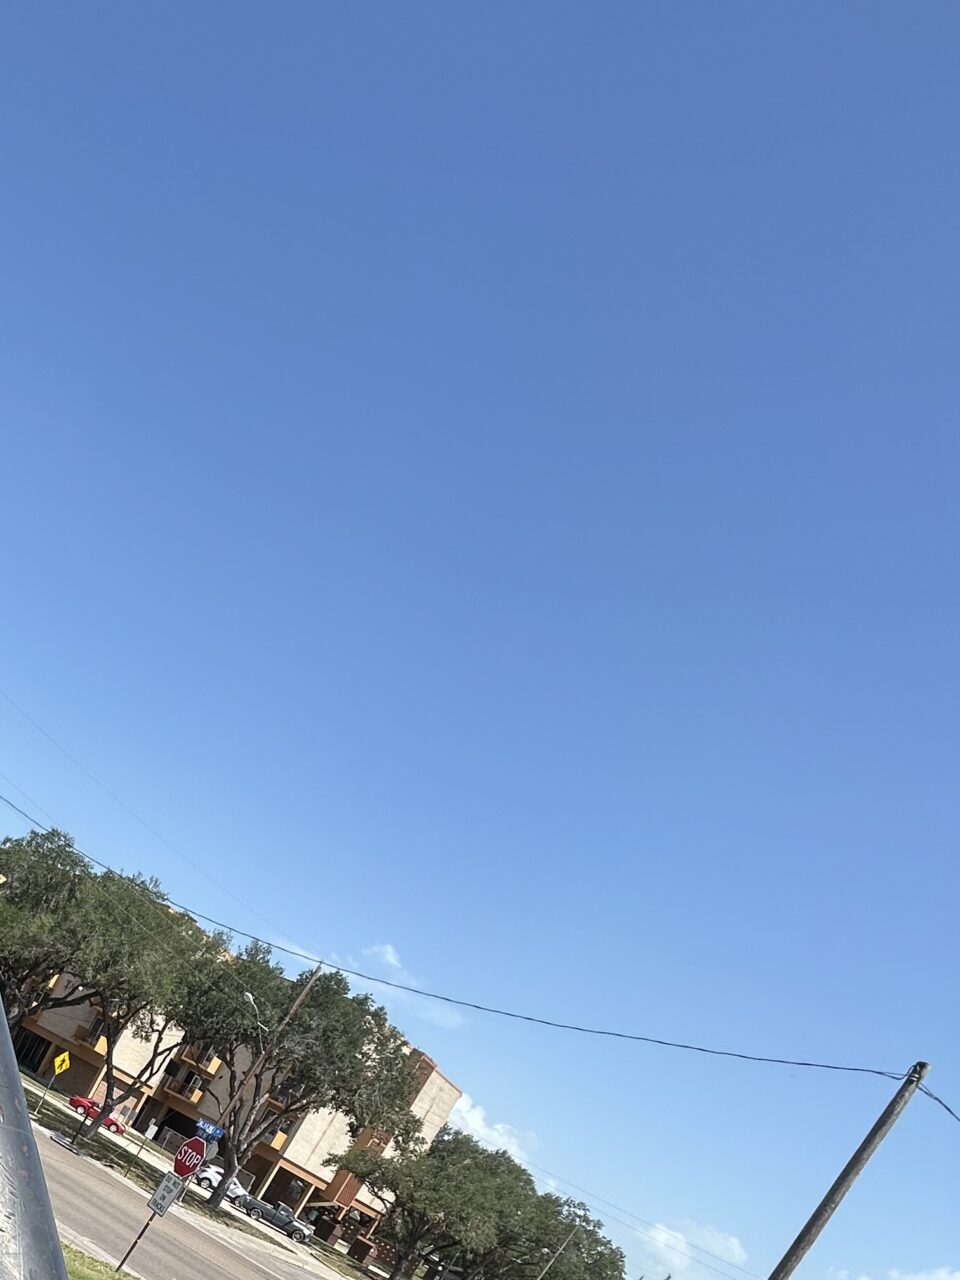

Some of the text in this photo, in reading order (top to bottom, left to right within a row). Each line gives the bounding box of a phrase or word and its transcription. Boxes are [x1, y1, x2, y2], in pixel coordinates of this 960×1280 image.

[178, 1146, 201, 1167] STOP
[163, 1185, 173, 1193] STOP
[159, 1193, 166, 1201] ON
[151, 1198, 166, 1212] TRACKS
